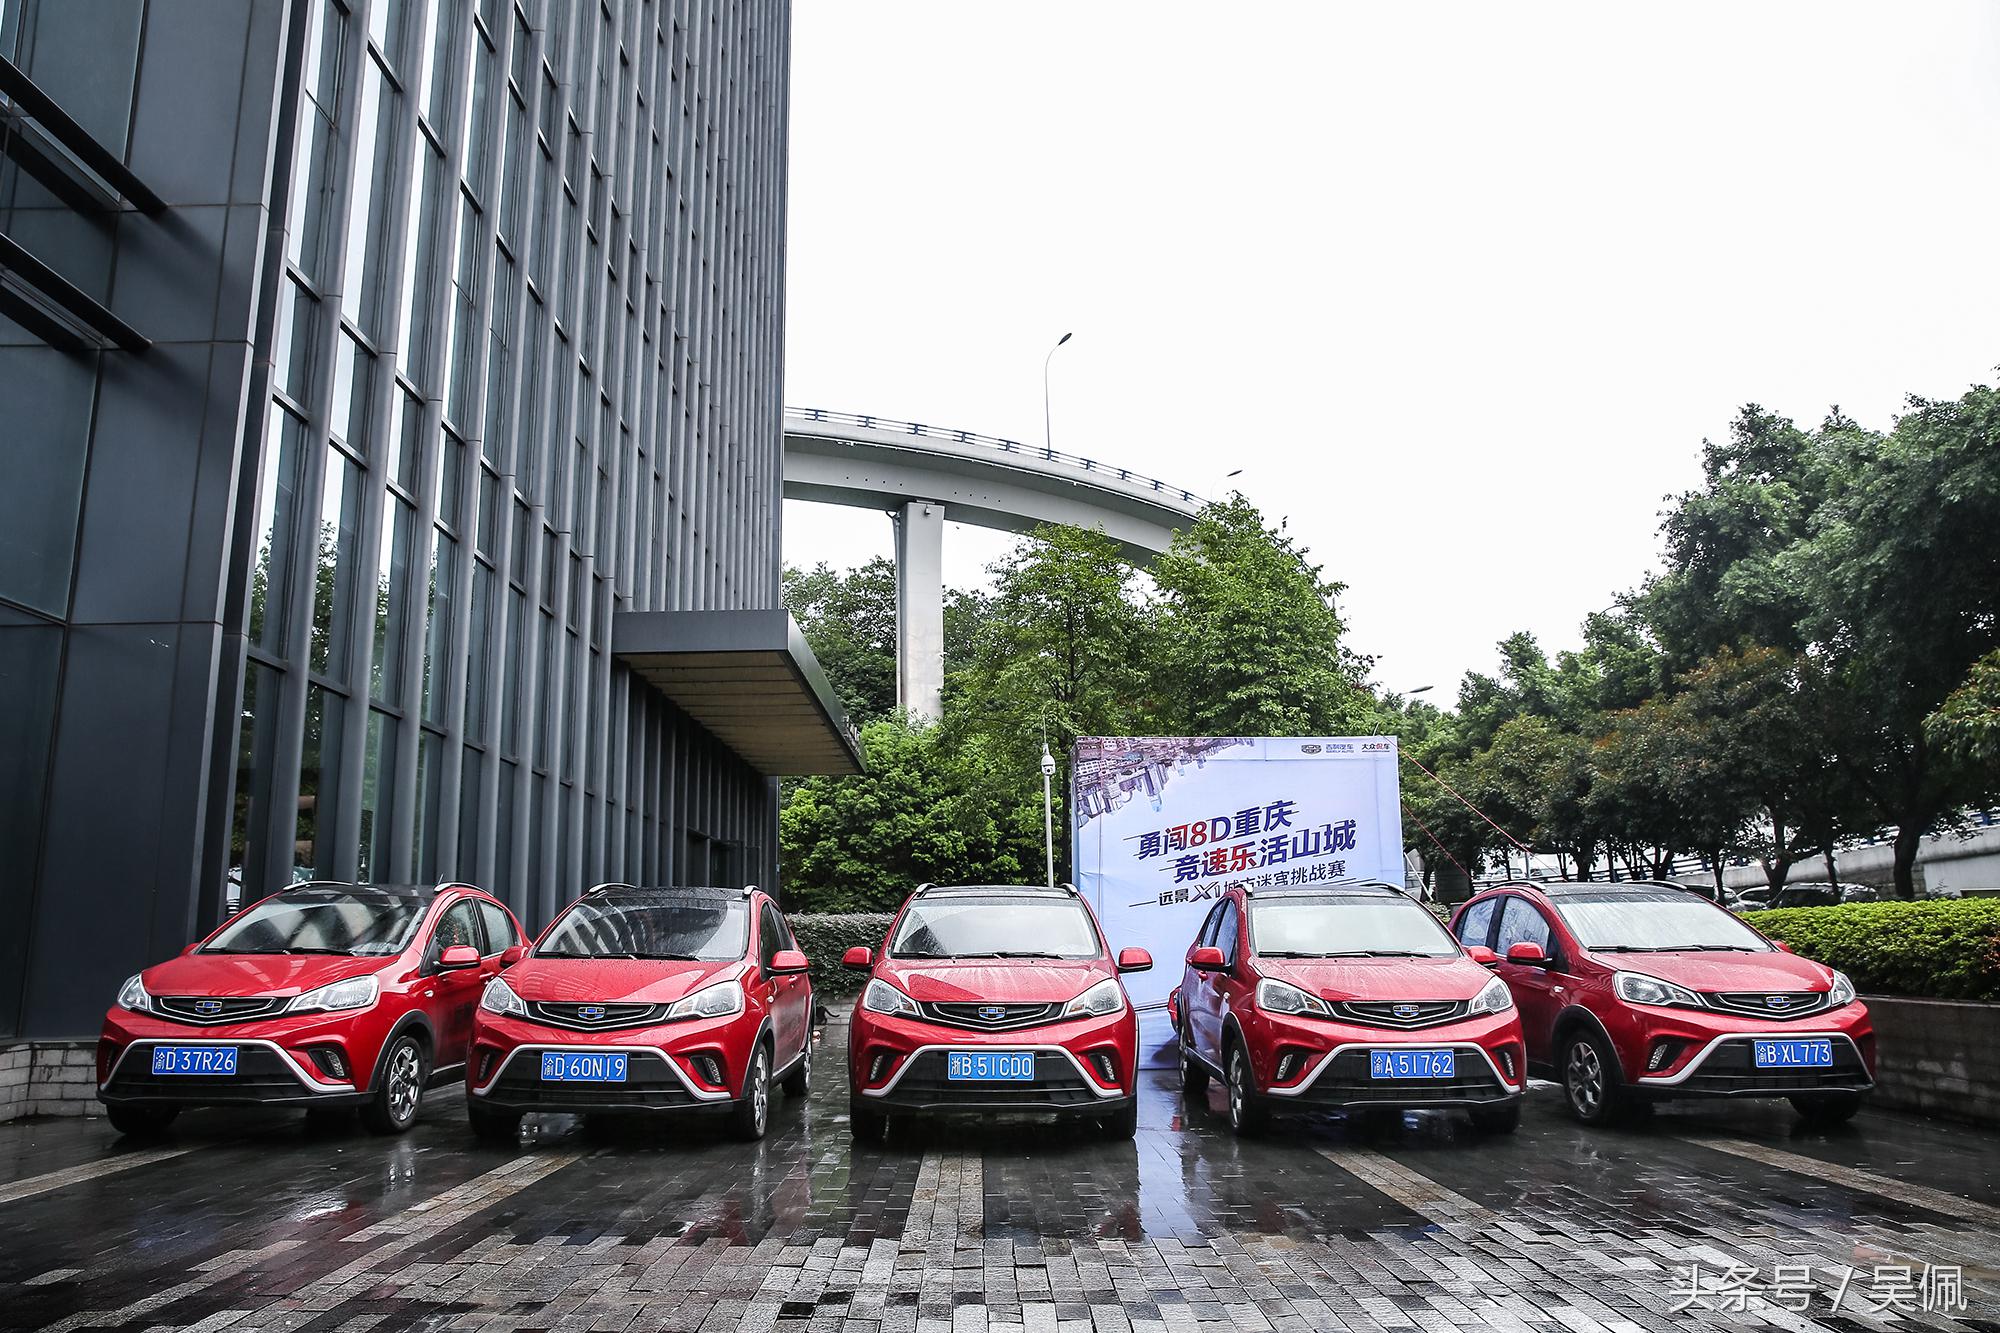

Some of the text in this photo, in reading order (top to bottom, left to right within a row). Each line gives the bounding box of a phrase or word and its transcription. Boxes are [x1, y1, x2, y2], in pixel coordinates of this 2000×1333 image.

[1137, 800, 1296, 861] 勇闯8D重庆
[1173, 819, 1357, 883] 竞速乐活山城
